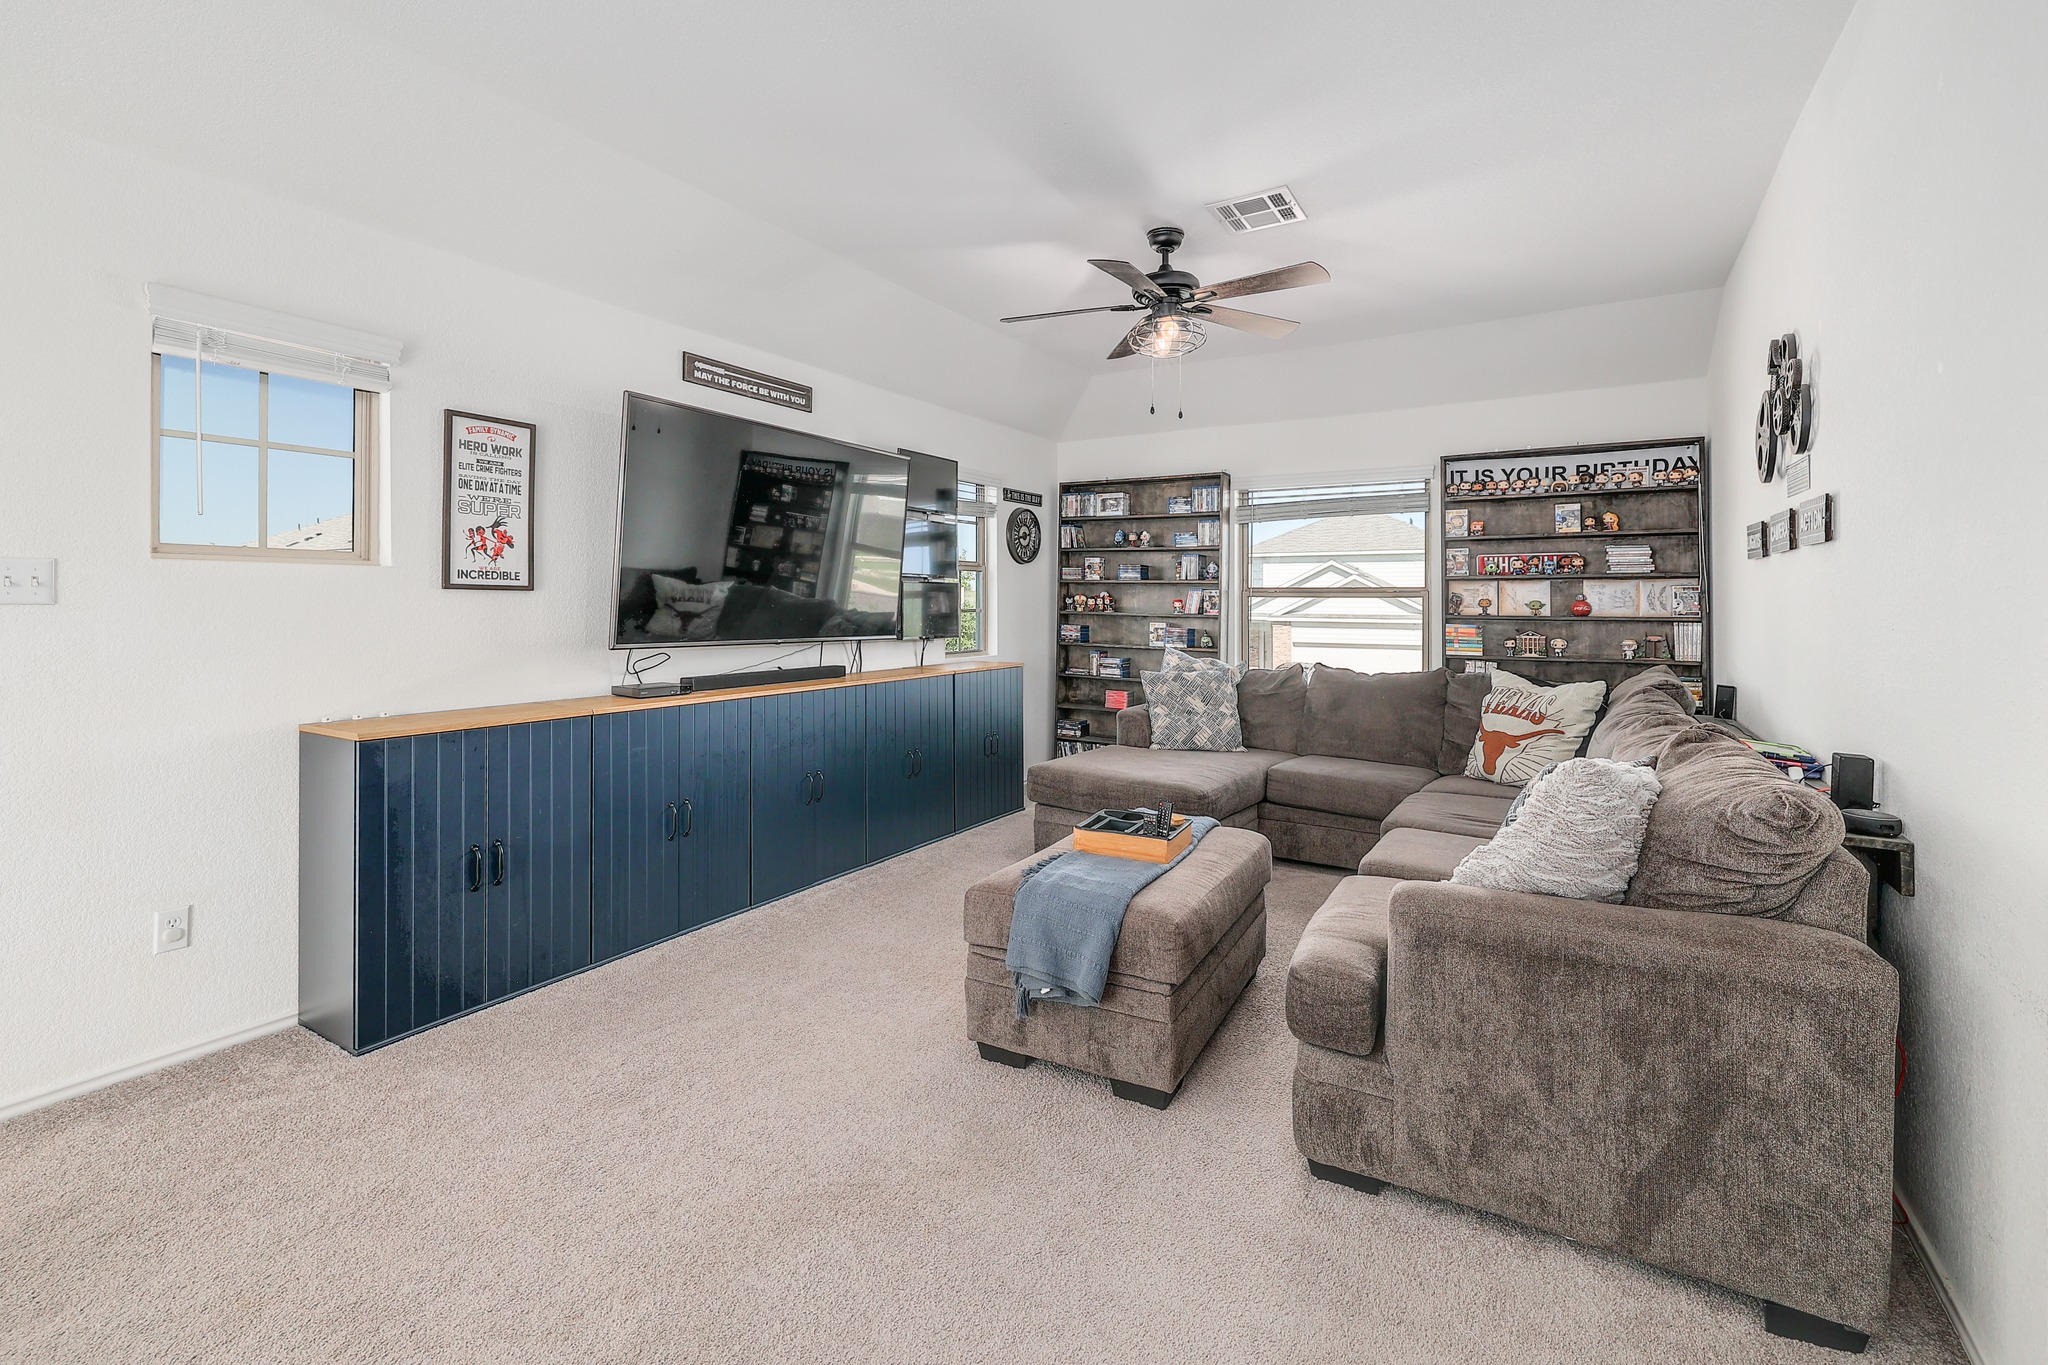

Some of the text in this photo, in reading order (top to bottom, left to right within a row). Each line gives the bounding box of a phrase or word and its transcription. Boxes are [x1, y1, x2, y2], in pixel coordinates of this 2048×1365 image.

[694, 369, 806, 405] MAY THE FORCE BE WITH YOU
[468, 426, 514, 441] FAMILY DYNAMIC
[458, 438, 523, 458] HERO WORK
[458, 462, 522, 477] ELITE CRIME FIGHTERS
[1450, 470, 1468, 484] IT
[1475, 469, 1494, 482] IS
[1500, 465, 1568, 482] YOUR
[458, 478, 522, 496] ONE DAY AT A TIME
[458, 500, 522, 519] SUPER
[1799, 507, 1824, 533] ACTION
[457, 569, 521, 581] INCREDIBLE
[1482, 686, 1558, 726] TEXAS
